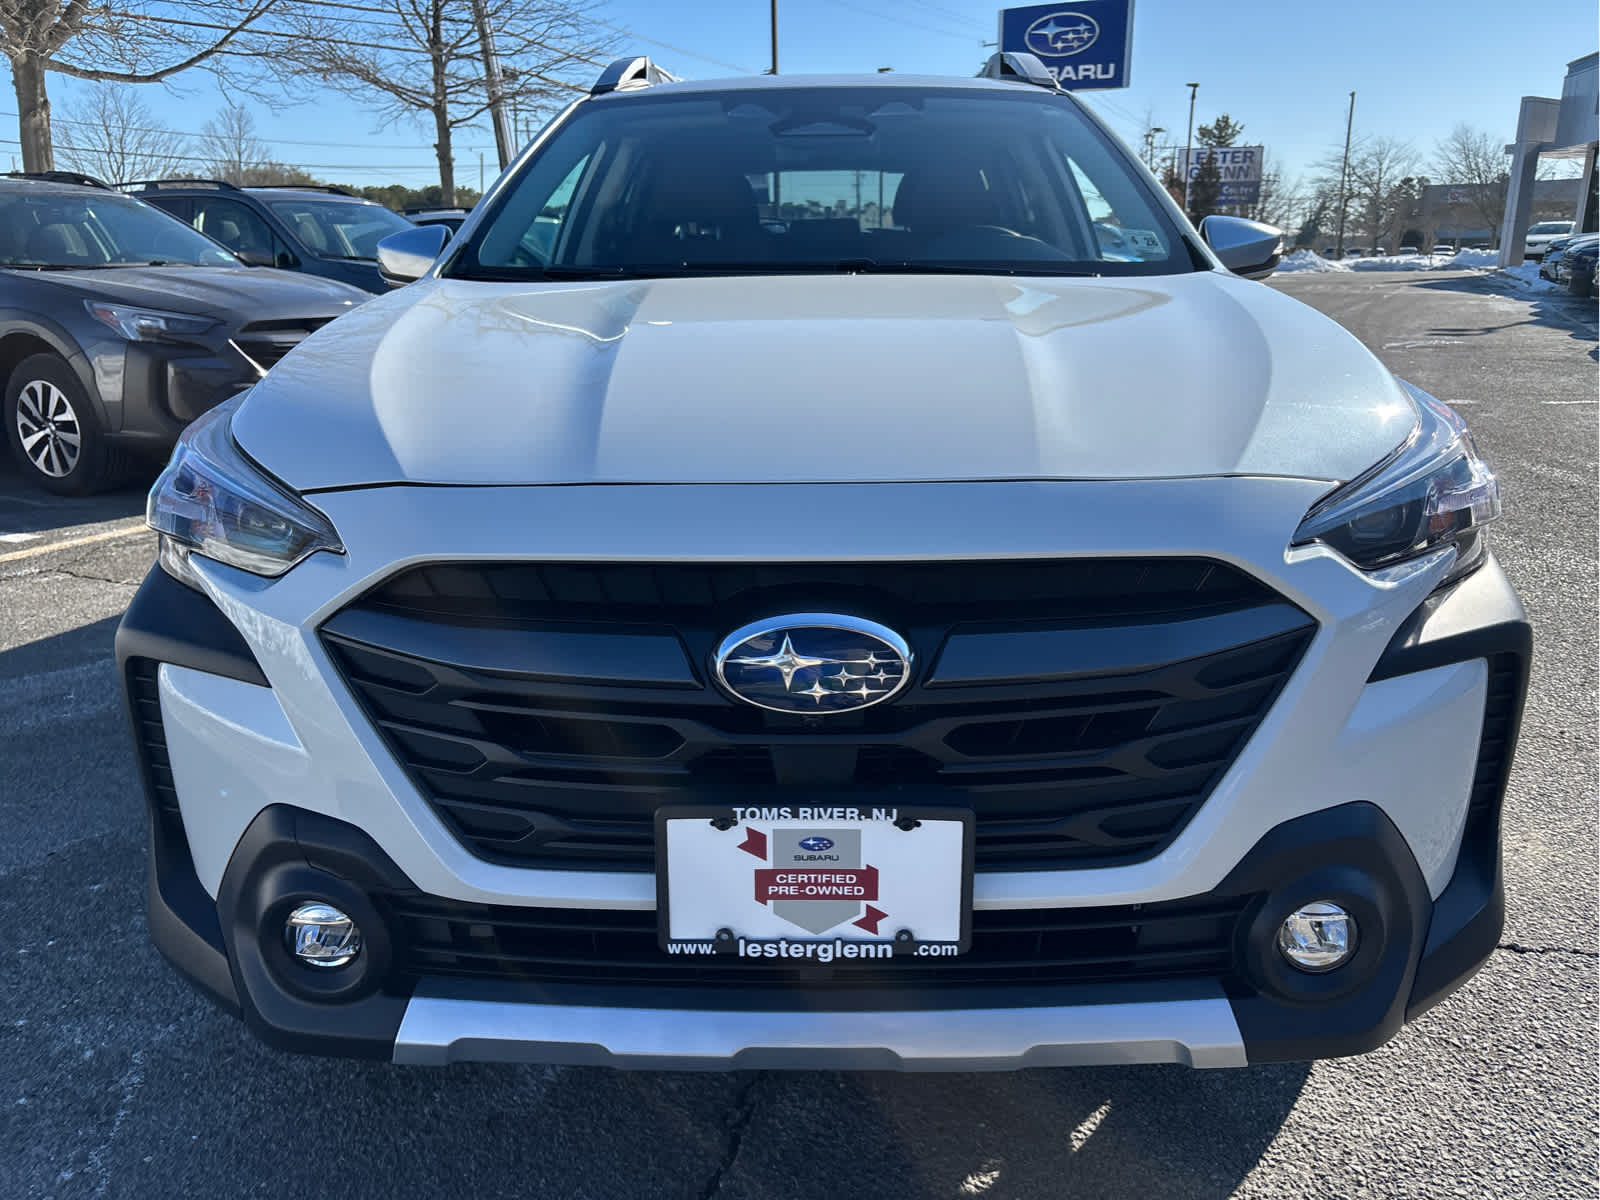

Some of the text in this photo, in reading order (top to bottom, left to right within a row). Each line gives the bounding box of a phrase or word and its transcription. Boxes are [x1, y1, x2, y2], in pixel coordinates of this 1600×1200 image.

[1048, 63, 1116, 82] BARU
[732, 807, 792, 821] TOMS
[872, 808, 898, 822] NJ
[793, 854, 840, 862] SUBARU
[776, 874, 857, 884] CERTIFIED
[768, 886, 865, 896] PRE-OWNED
[667, 938, 958, 962] www. lesterglenn .com
